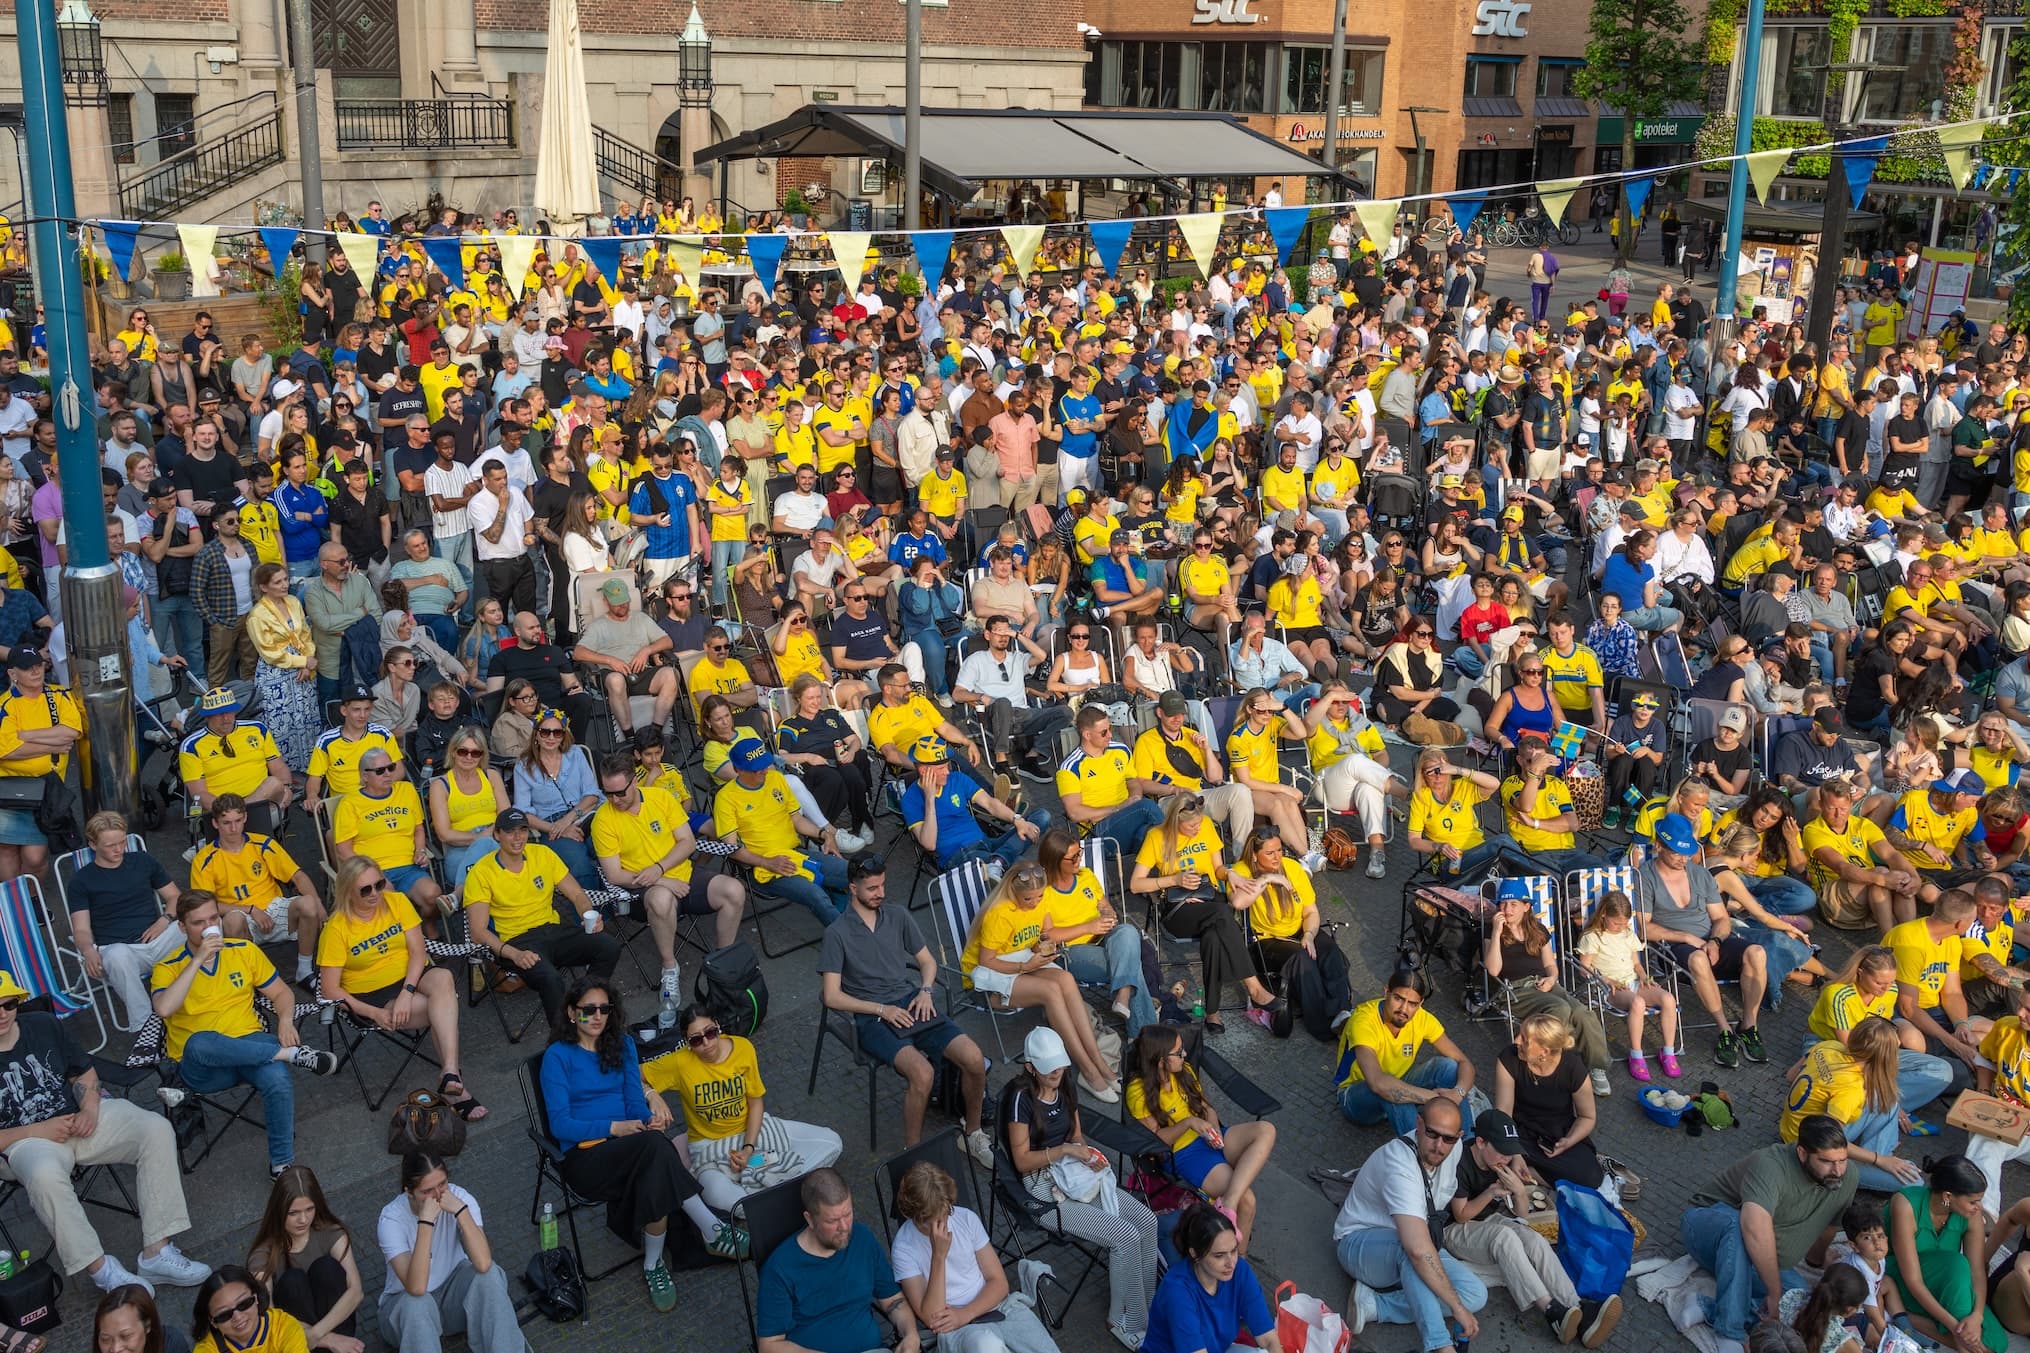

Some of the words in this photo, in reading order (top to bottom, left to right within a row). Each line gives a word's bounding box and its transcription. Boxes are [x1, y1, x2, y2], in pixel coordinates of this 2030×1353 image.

[1642, 122, 1678, 139] apoteket
[904, 545, 919, 560] 22
[364, 806, 409, 823] SVERIGE
[1442, 818, 1453, 832] 9
[234, 884, 249, 900] 11
[1012, 924, 1041, 947] SVERIG
